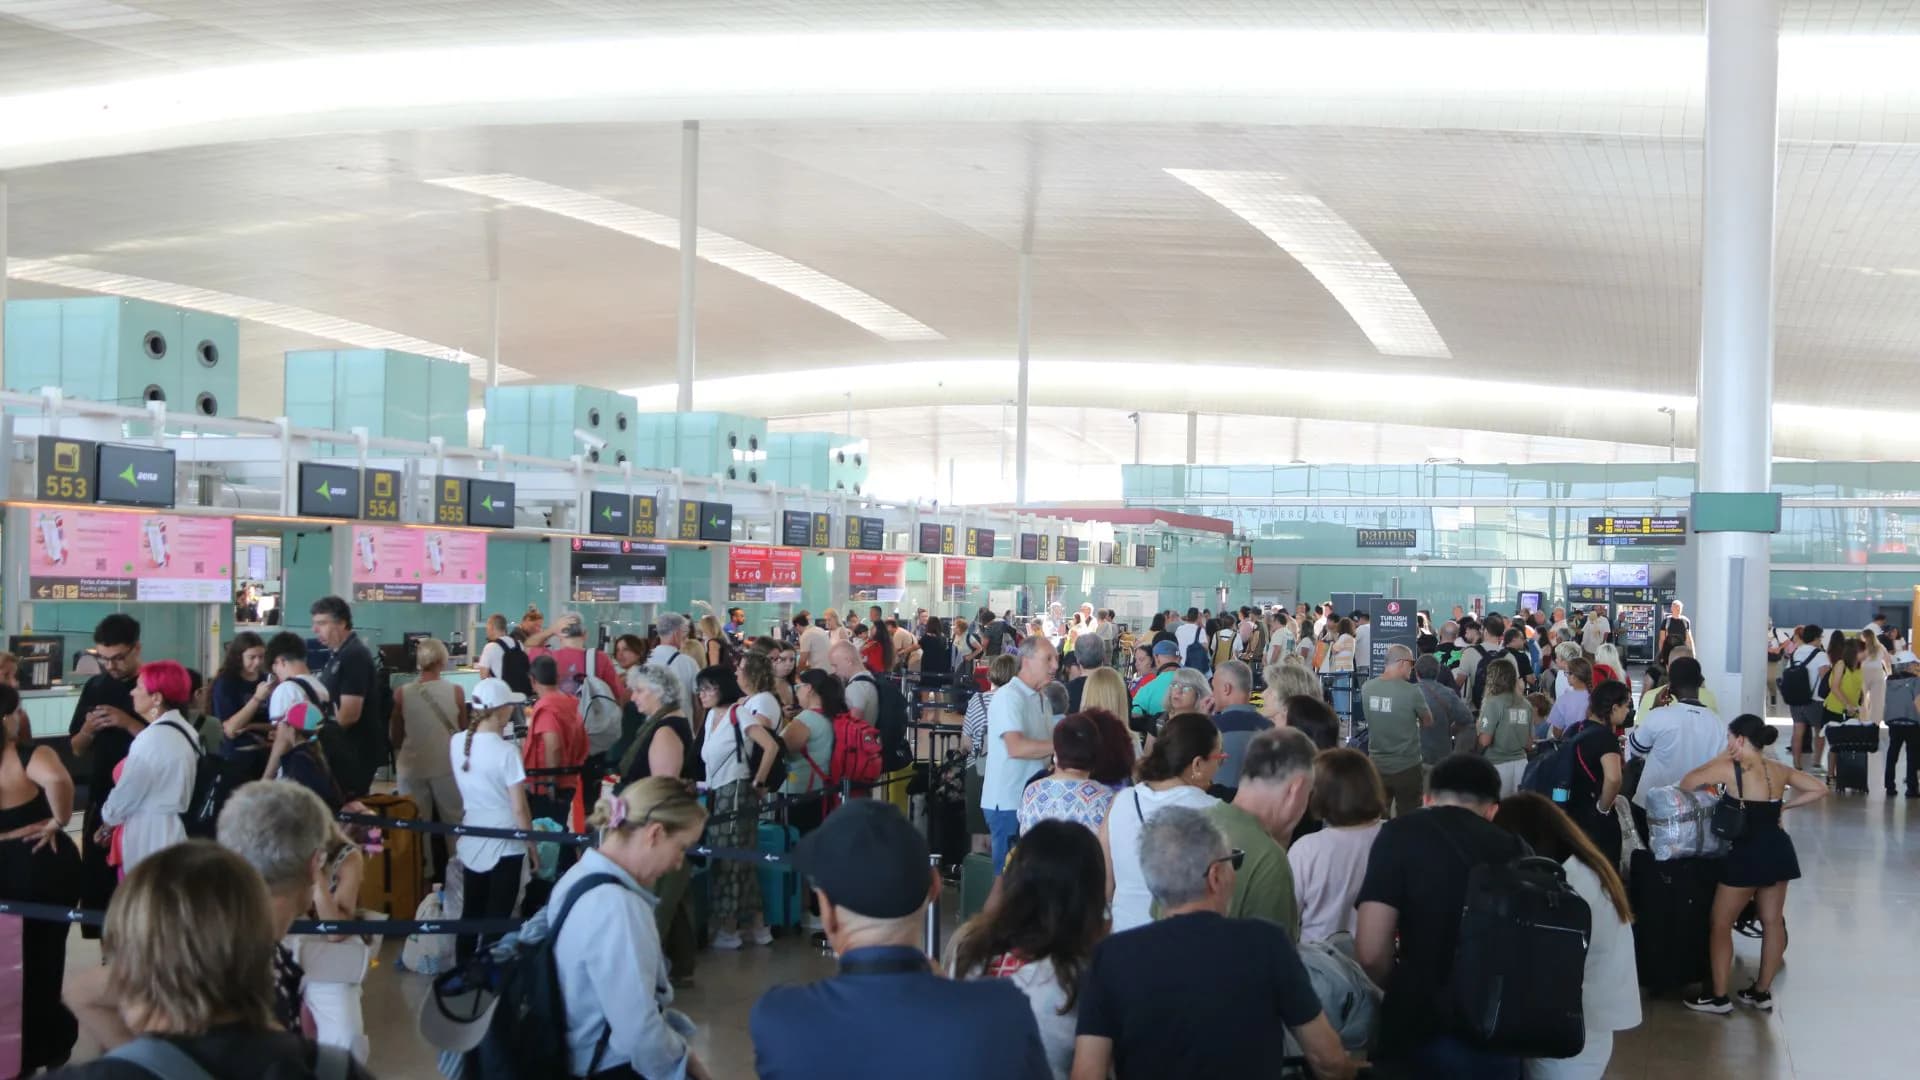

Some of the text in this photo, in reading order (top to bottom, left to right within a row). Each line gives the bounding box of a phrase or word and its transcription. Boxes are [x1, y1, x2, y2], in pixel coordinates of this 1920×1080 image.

[136, 472, 158, 481] aena
[46, 475, 87, 498] 553
[368, 499, 397, 517] 554
[439, 505, 464, 522] 555
[635, 520, 654, 534] 556
[682, 523, 698, 537] 557
[1360, 530, 1415, 542] pannus
